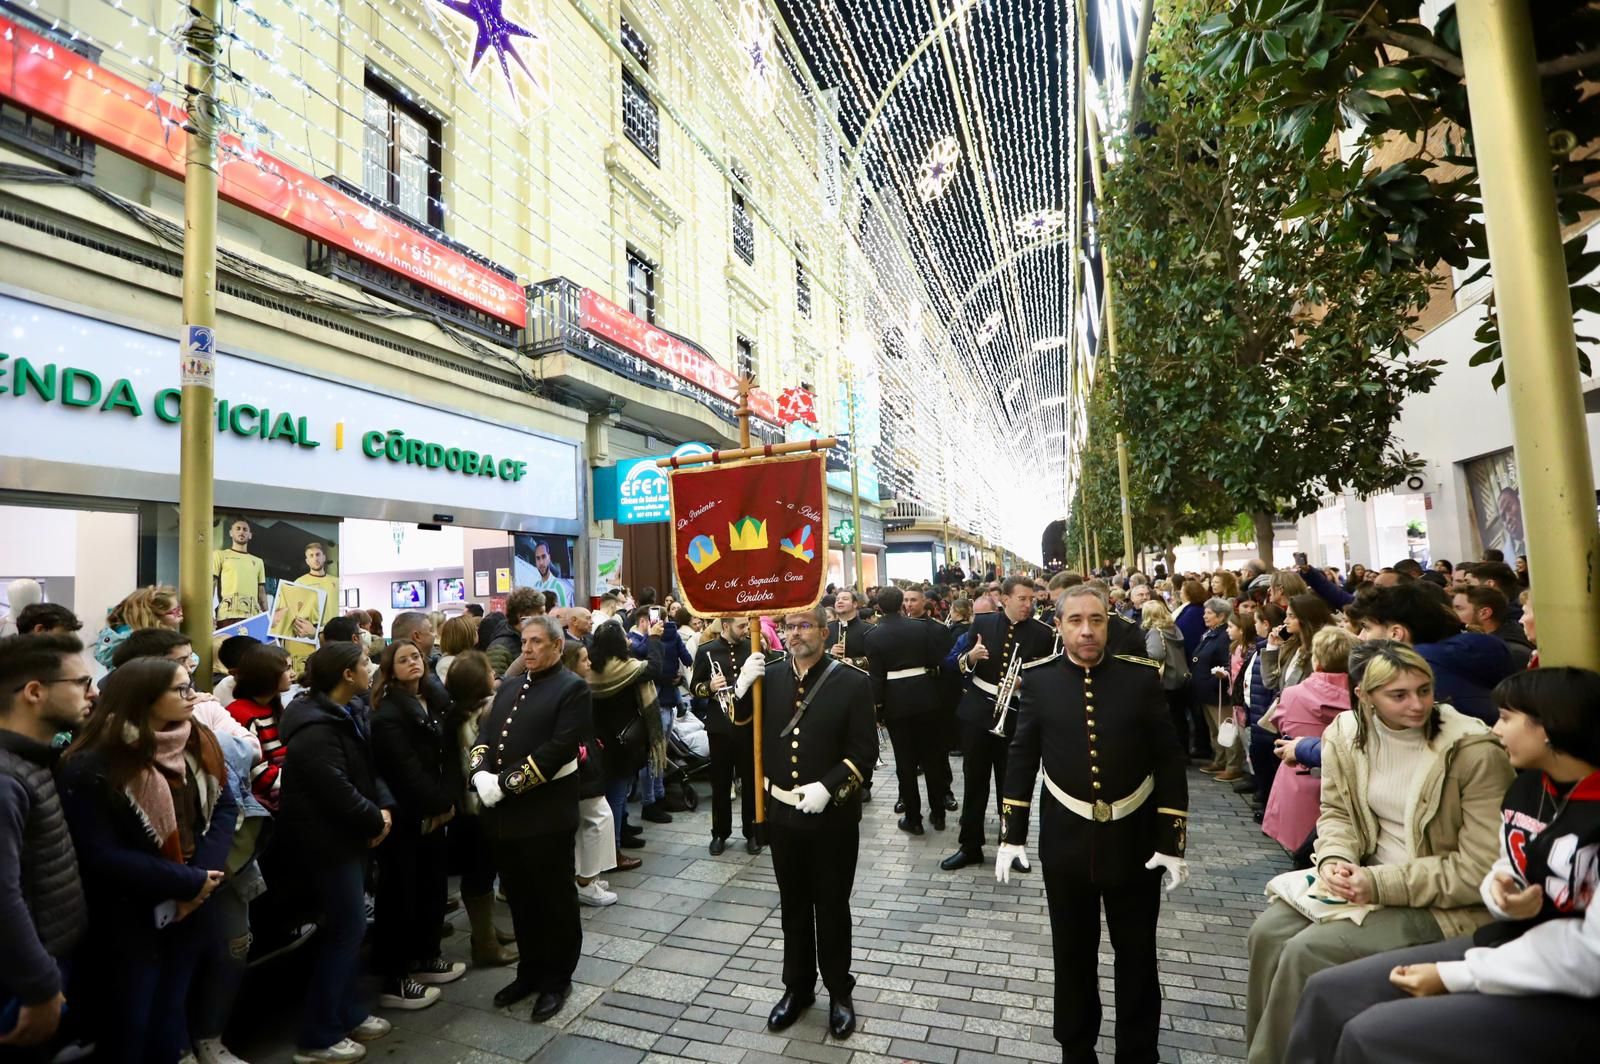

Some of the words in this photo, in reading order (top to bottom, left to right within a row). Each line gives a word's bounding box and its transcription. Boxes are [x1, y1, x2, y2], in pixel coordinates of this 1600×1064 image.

[153, 387, 321, 448] OICIAL
[498, 457, 528, 483] CF
[620, 476, 669, 497] EFET
[677, 518, 689, 530] De
[688, 500, 716, 523] Poniente
[797, 504, 821, 523] Belén
[704, 579, 720, 591] A.
[747, 573, 780, 589] Sagrada
[784, 571, 804, 583] Cena
[735, 588, 775, 604] Córdoba
